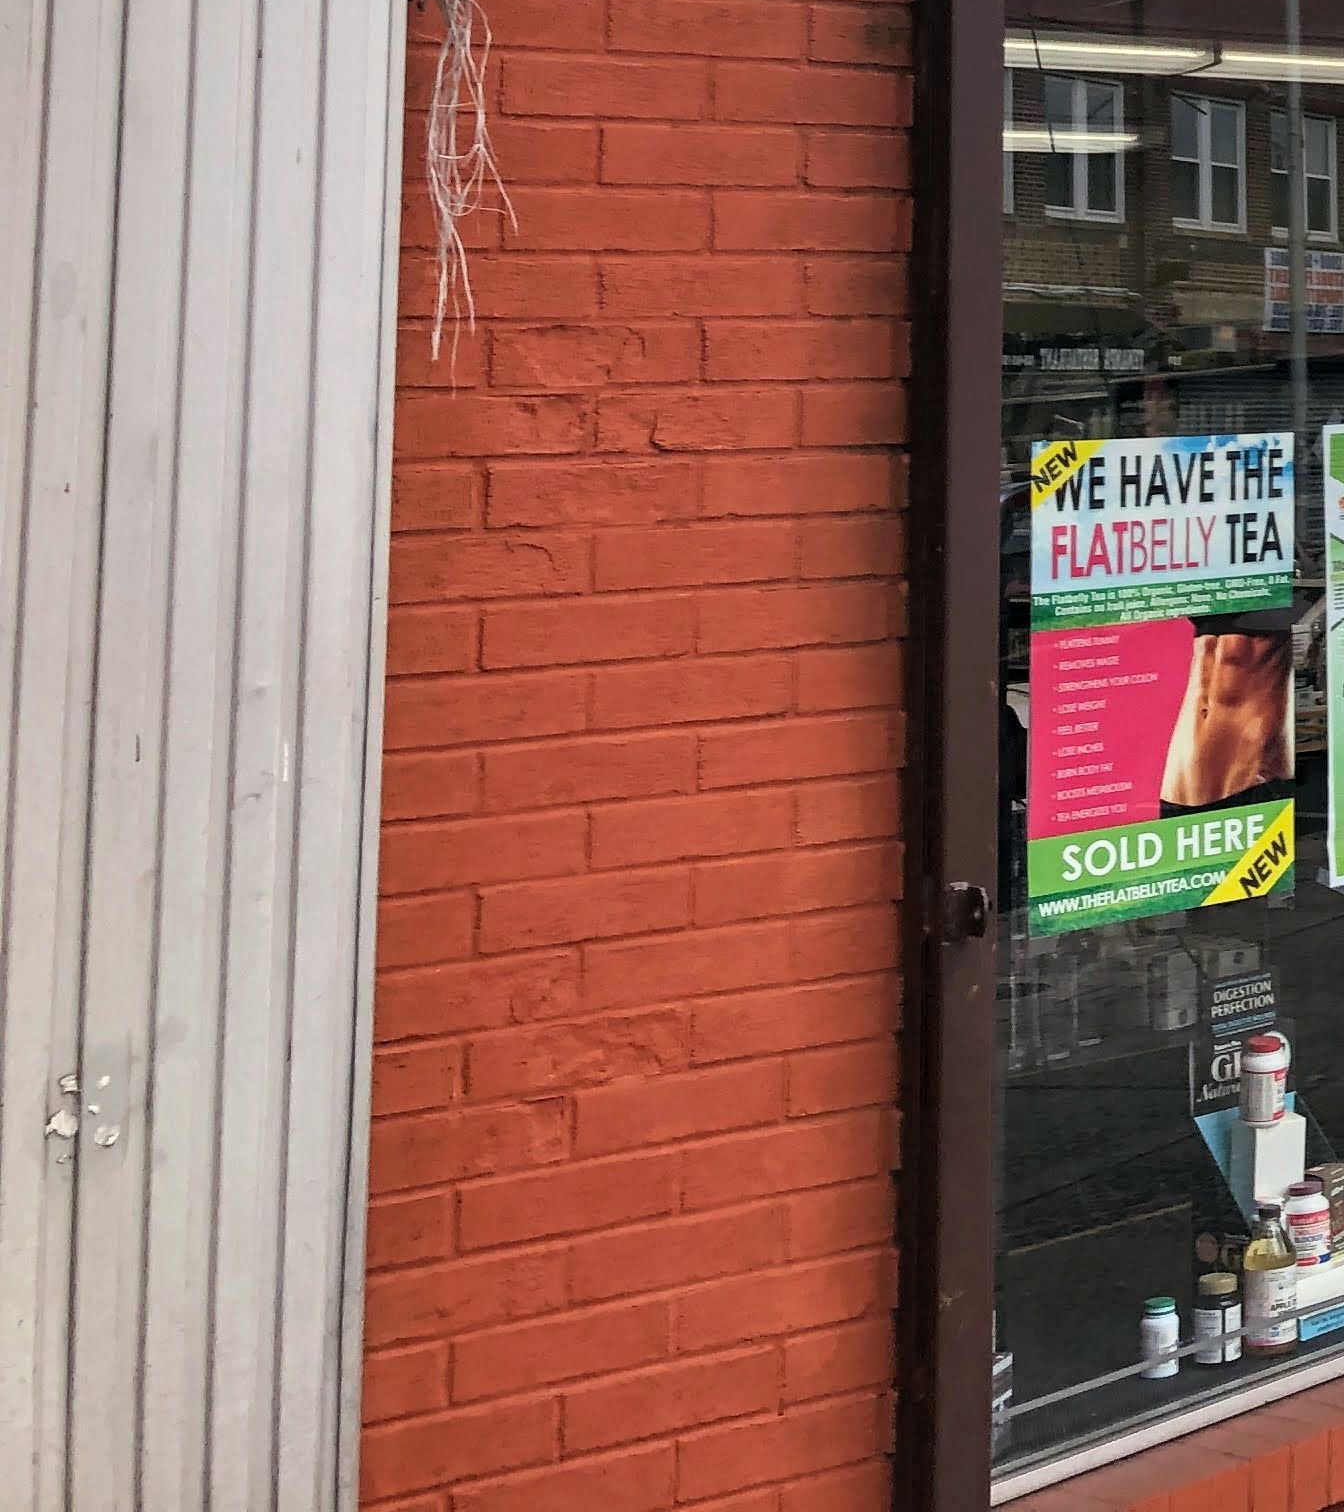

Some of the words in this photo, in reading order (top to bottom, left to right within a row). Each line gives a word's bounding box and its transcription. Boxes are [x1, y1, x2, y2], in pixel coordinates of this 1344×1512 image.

[1030, 441, 1078, 493] NEW
[1055, 457, 1105, 512] WE
[1120, 452, 1214, 508] HAVE
[1226, 449, 1283, 501] THE
[1052, 515, 1216, 579] FLATBELLY
[1226, 511, 1283, 564] TEA
[1061, 832, 1163, 882] SOLD
[1176, 814, 1264, 861] HERE
[1238, 830, 1288, 897] NEW
[1038, 869, 1226, 918] WWW.THEFLATBELLYTEA.COM
[1211, 993, 1275, 1018] PERFECTION
[1213, 980, 1272, 1004] DIGESTION
